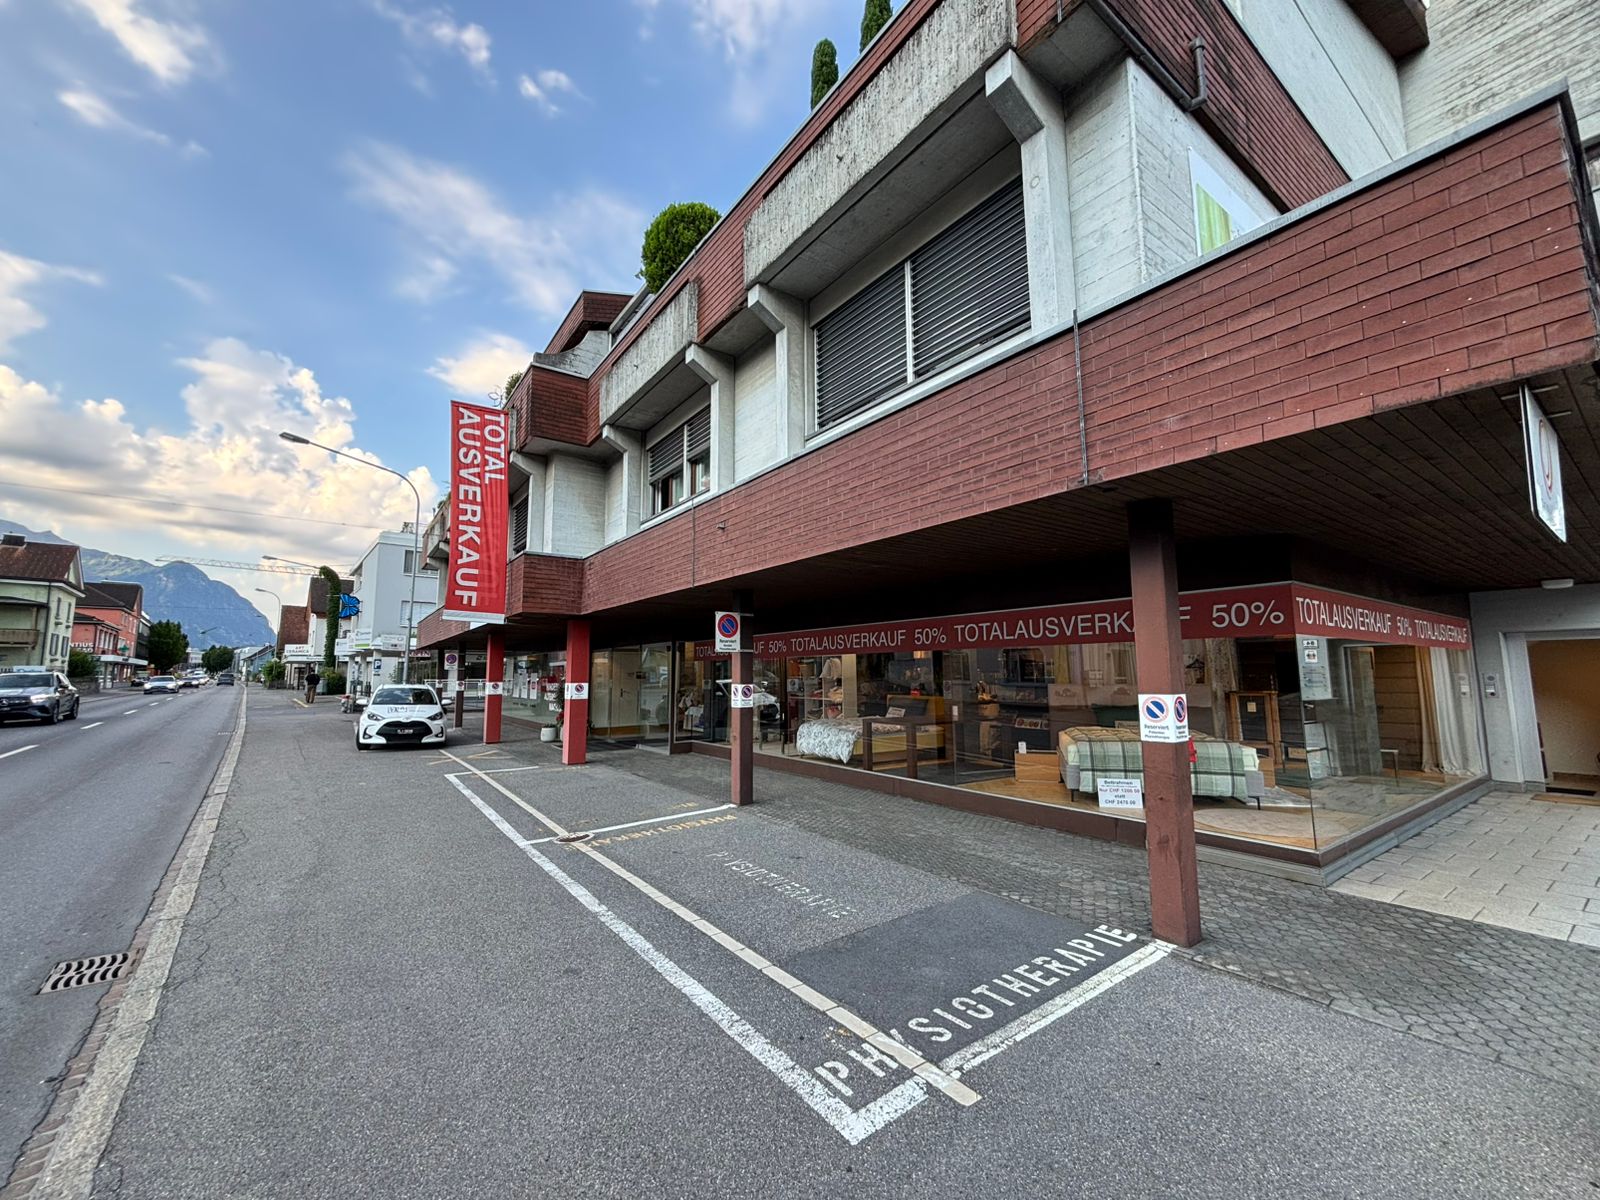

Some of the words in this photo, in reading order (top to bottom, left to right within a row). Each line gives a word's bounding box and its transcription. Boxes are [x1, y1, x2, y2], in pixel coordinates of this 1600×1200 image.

[483, 413, 505, 485] TOTAL
[455, 407, 482, 607] AUSVERKAUF
[768, 640, 787, 654] 50%
[790, 629, 906, 652] TOTALAUSVERKAUF
[914, 627, 946, 645] 50%
[1212, 599, 1285, 629] 50%
[1296, 596, 1392, 634] TOTALAUSVERKAUF
[1396, 616, 1413, 637] 50%
[1414, 619, 1468, 643] TOTALAUSVERKAUF
